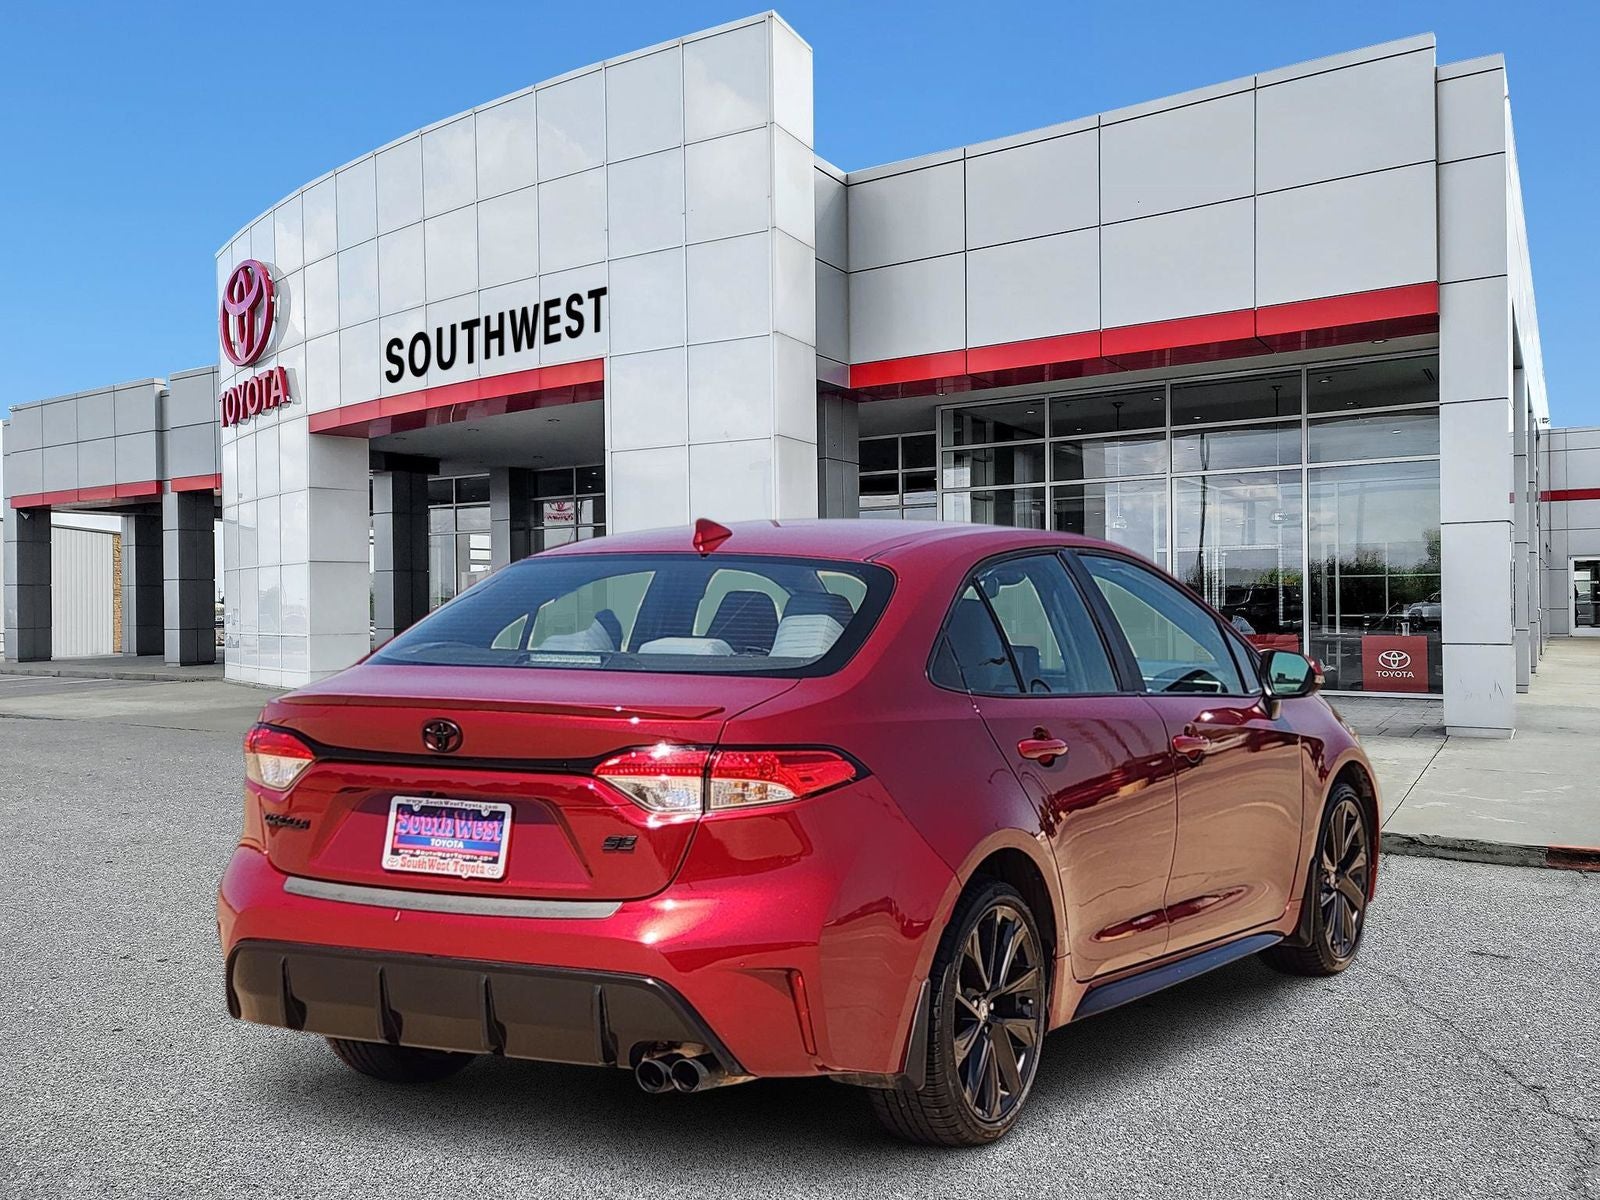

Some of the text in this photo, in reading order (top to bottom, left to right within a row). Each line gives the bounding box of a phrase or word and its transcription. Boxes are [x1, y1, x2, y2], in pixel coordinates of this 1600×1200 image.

[385, 287, 607, 383] SOUTHWEST
[219, 366, 288, 427] TOYOTA
[1376, 670, 1414, 678] TOYOTA
[430, 838, 464, 849] TOYOTA
[603, 834, 638, 851] SE
[400, 857, 485, 875] SouthWest Toyota
